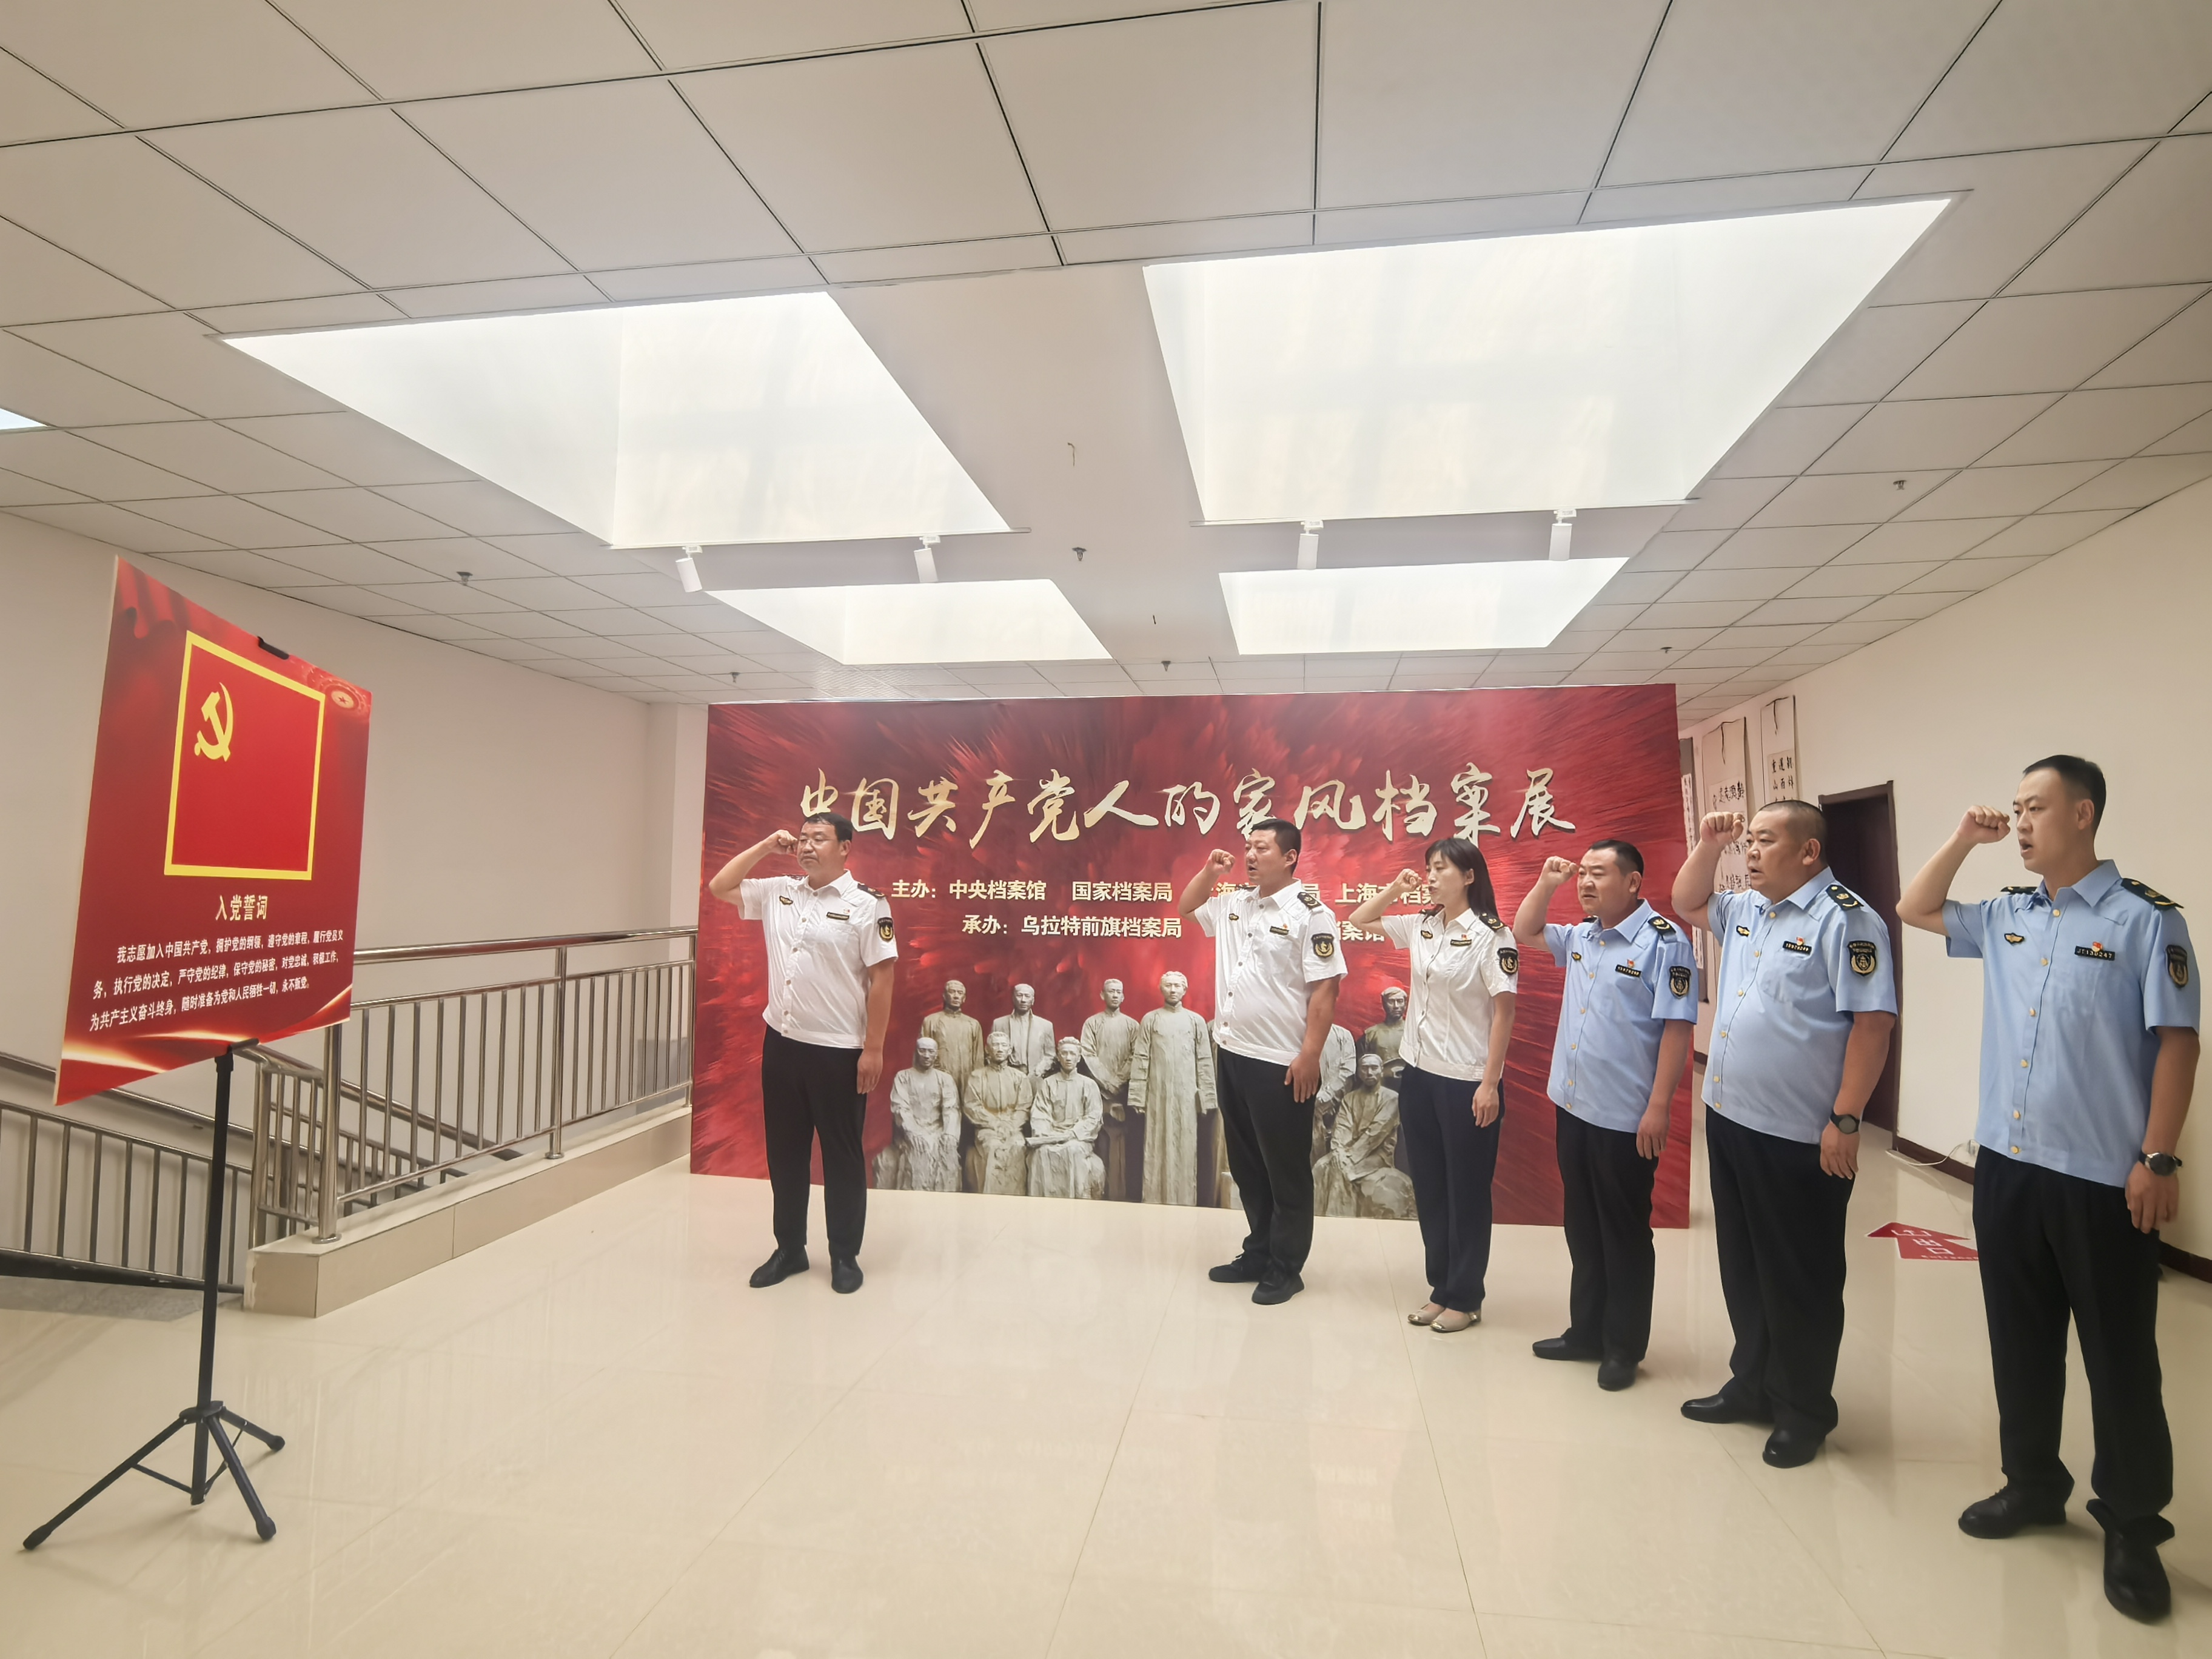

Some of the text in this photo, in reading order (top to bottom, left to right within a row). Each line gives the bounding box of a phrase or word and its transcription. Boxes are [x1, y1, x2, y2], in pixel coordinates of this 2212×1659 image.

[1071, 881, 1173, 902] 国家档案局
[215, 894, 269, 922] 入党誓词
[962, 914, 1182, 939] 承办：乌拉特前旗档案局
